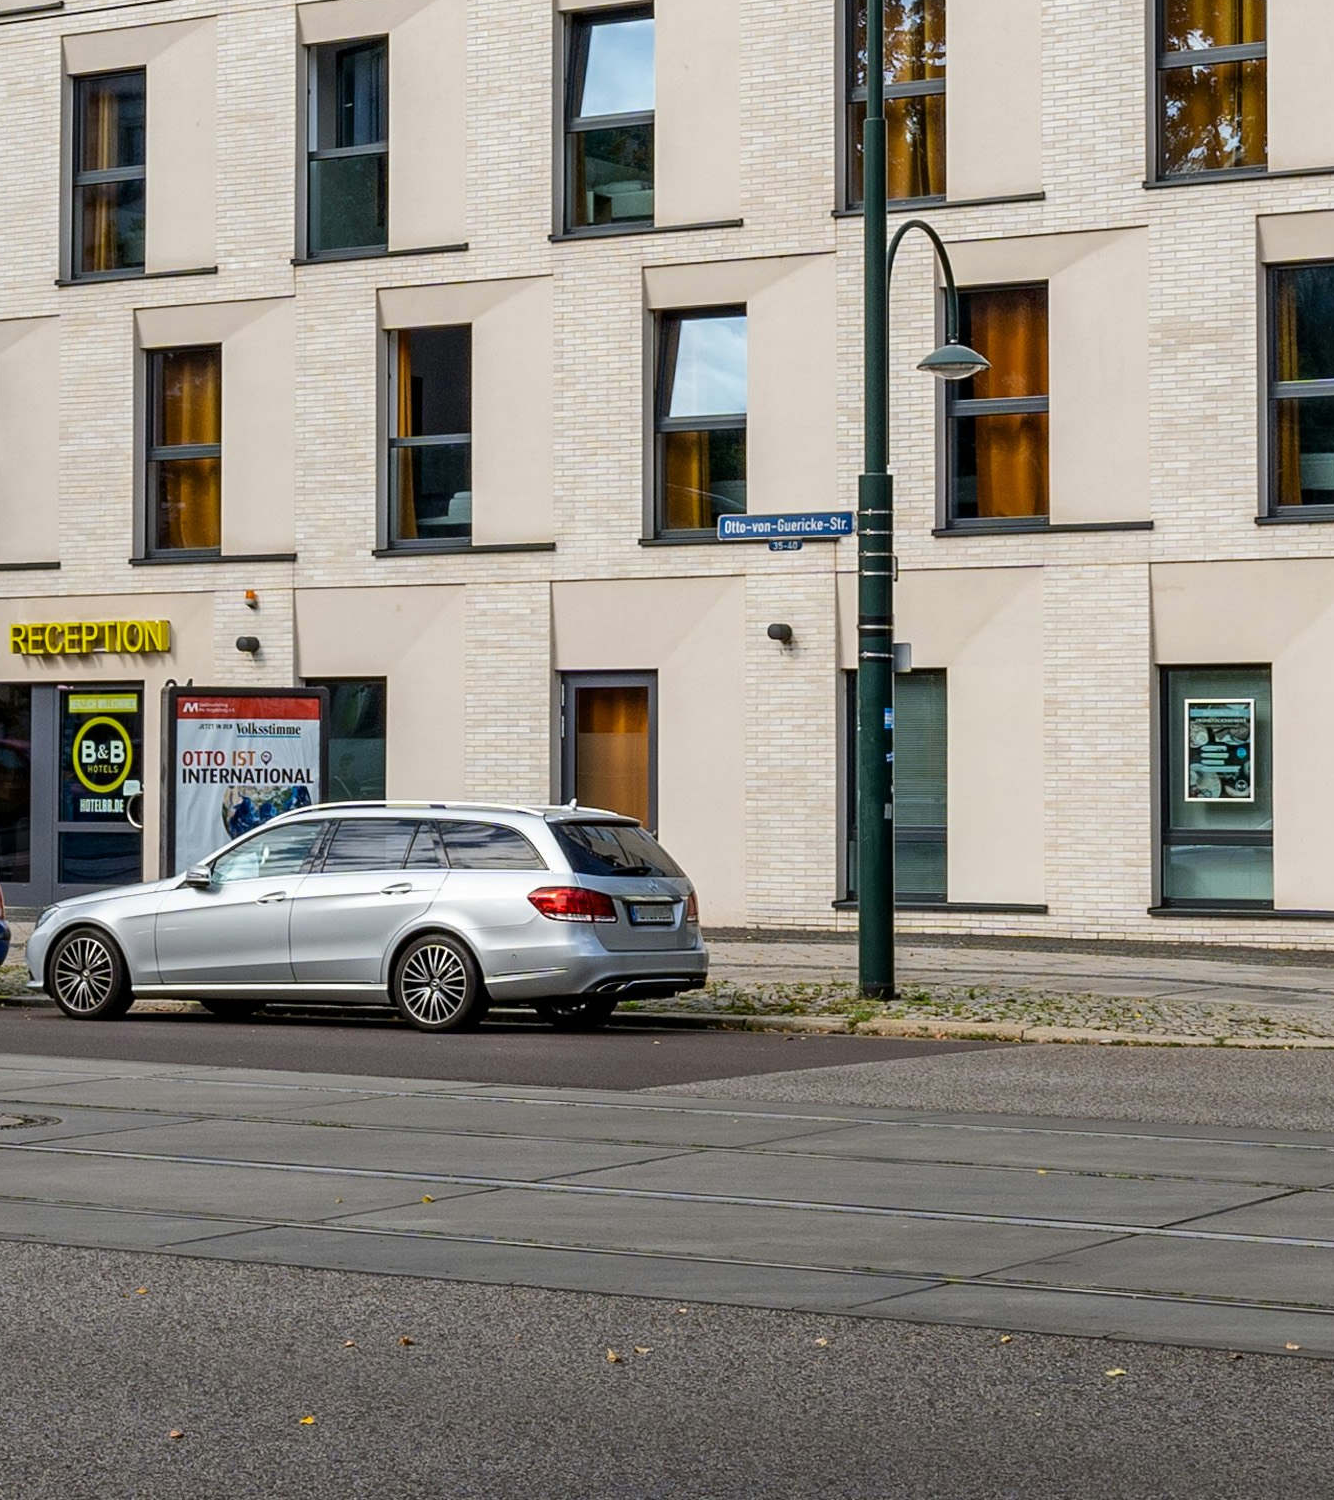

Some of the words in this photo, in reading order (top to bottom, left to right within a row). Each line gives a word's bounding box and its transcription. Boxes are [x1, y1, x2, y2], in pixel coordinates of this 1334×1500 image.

[724, 517, 849, 534] Otto-von-Guericke-Str.
[773, 541, 798, 550] 35-40
[10, 620, 164, 654] RECEPTION
[236, 723, 302, 736] Volksstimme
[81, 740, 126, 763] B&B
[182, 750, 226, 767] OTTO
[232, 750, 256, 767] IST
[87, 765, 119, 774] HOTELS
[182, 768, 314, 784] INTERNATIONAL
[79, 799, 124, 813] HOTELBB.DE
